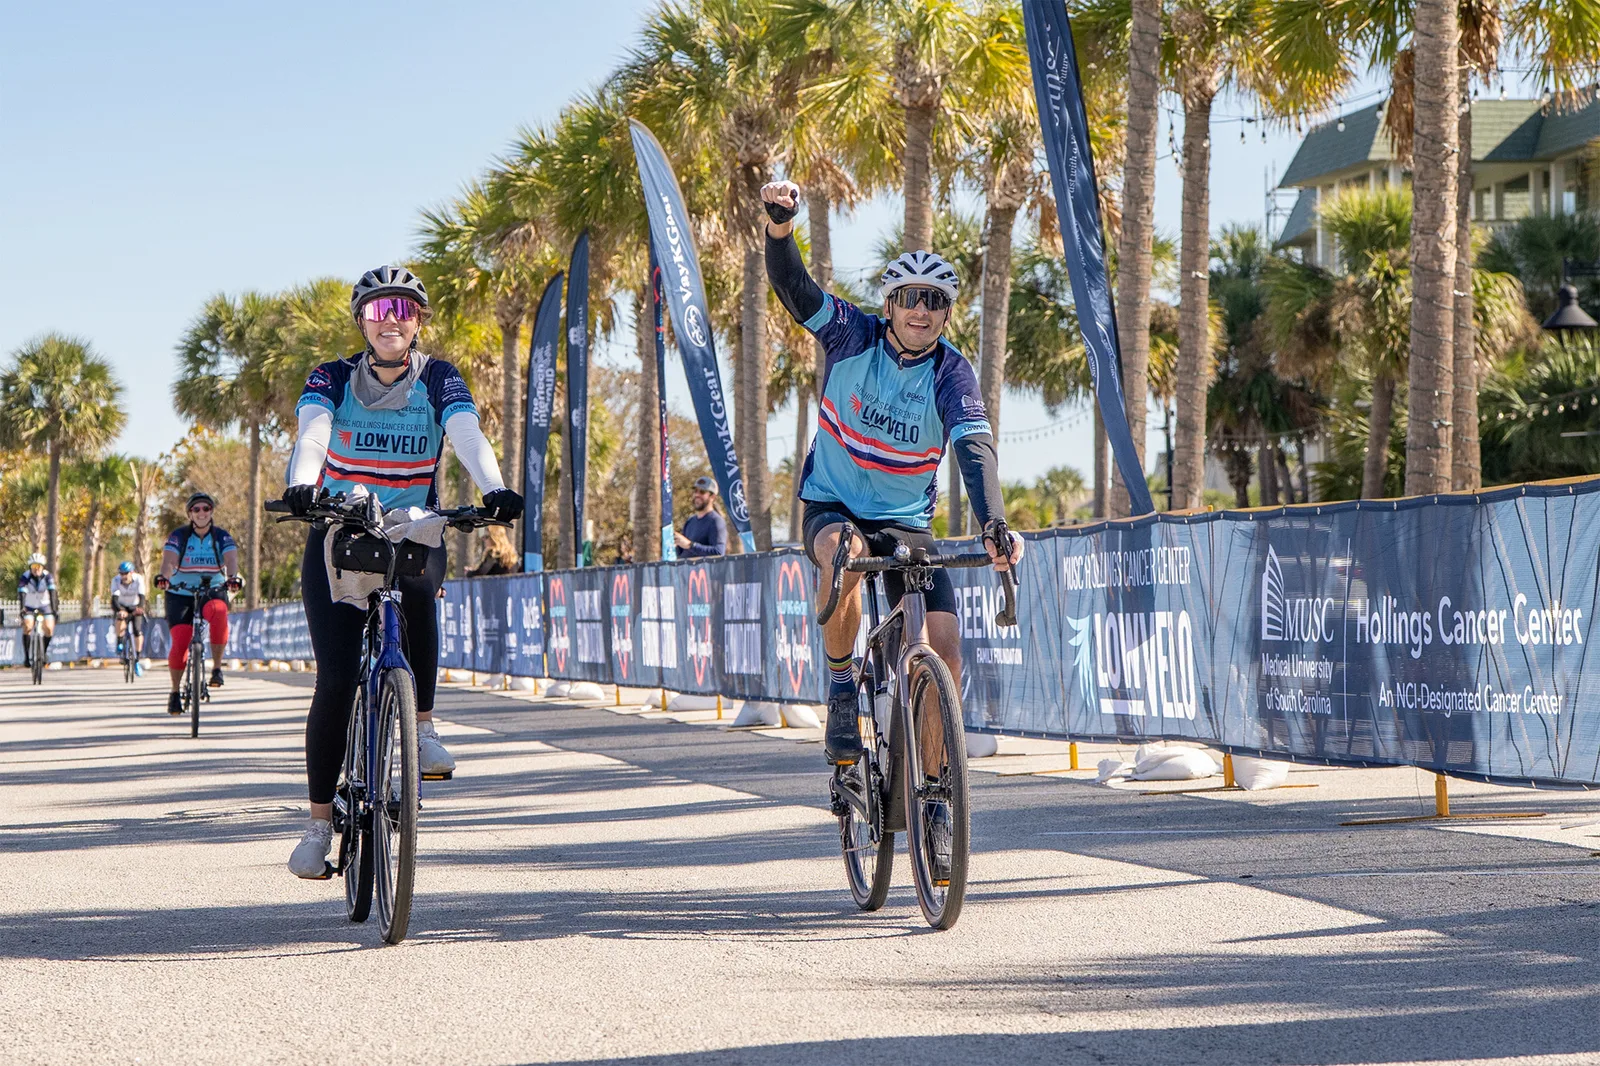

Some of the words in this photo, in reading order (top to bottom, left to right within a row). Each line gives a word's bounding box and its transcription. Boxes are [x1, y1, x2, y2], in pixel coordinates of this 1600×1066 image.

[1059, 53, 1069, 85] Future
[1069, 157, 1077, 177] with
[659, 192, 693, 304] VayKGear
[532, 398, 540, 426] The
[537, 363, 548, 427] InterTech
[351, 419, 381, 430] HOLLINGS
[381, 422, 405, 432] CANCER
[405, 423, 430, 433] CENTER
[703, 367, 740, 479] VayKGear
[355, 432, 428, 455] LOWVELO
[190, 556, 217, 565] LOWVEL
[1063, 555, 1084, 591] MUSC
[1084, 551, 1122, 589] HOLLINGS
[1123, 547, 1157, 587] CANCER
[1157, 546, 1191, 585] CENTER
[1284, 597, 1335, 643] MUSC
[1356, 595, 1433, 659] Hollings
[1438, 595, 1508, 646] Cancer
[1513, 592, 1583, 646] Center
[1094, 610, 1196, 721] LOWVELO
[1262, 652, 1291, 677] Medical
[1291, 653, 1334, 685] University
[1266, 687, 1274, 711] of
[1274, 687, 1298, 712] South
[1297, 688, 1332, 715] Carolina
[1378, 681, 1395, 708] An
[1396, 681, 1482, 719] NCI-Designated
[1484, 684, 1522, 714] Cancer
[1523, 684, 1563, 715] Center
